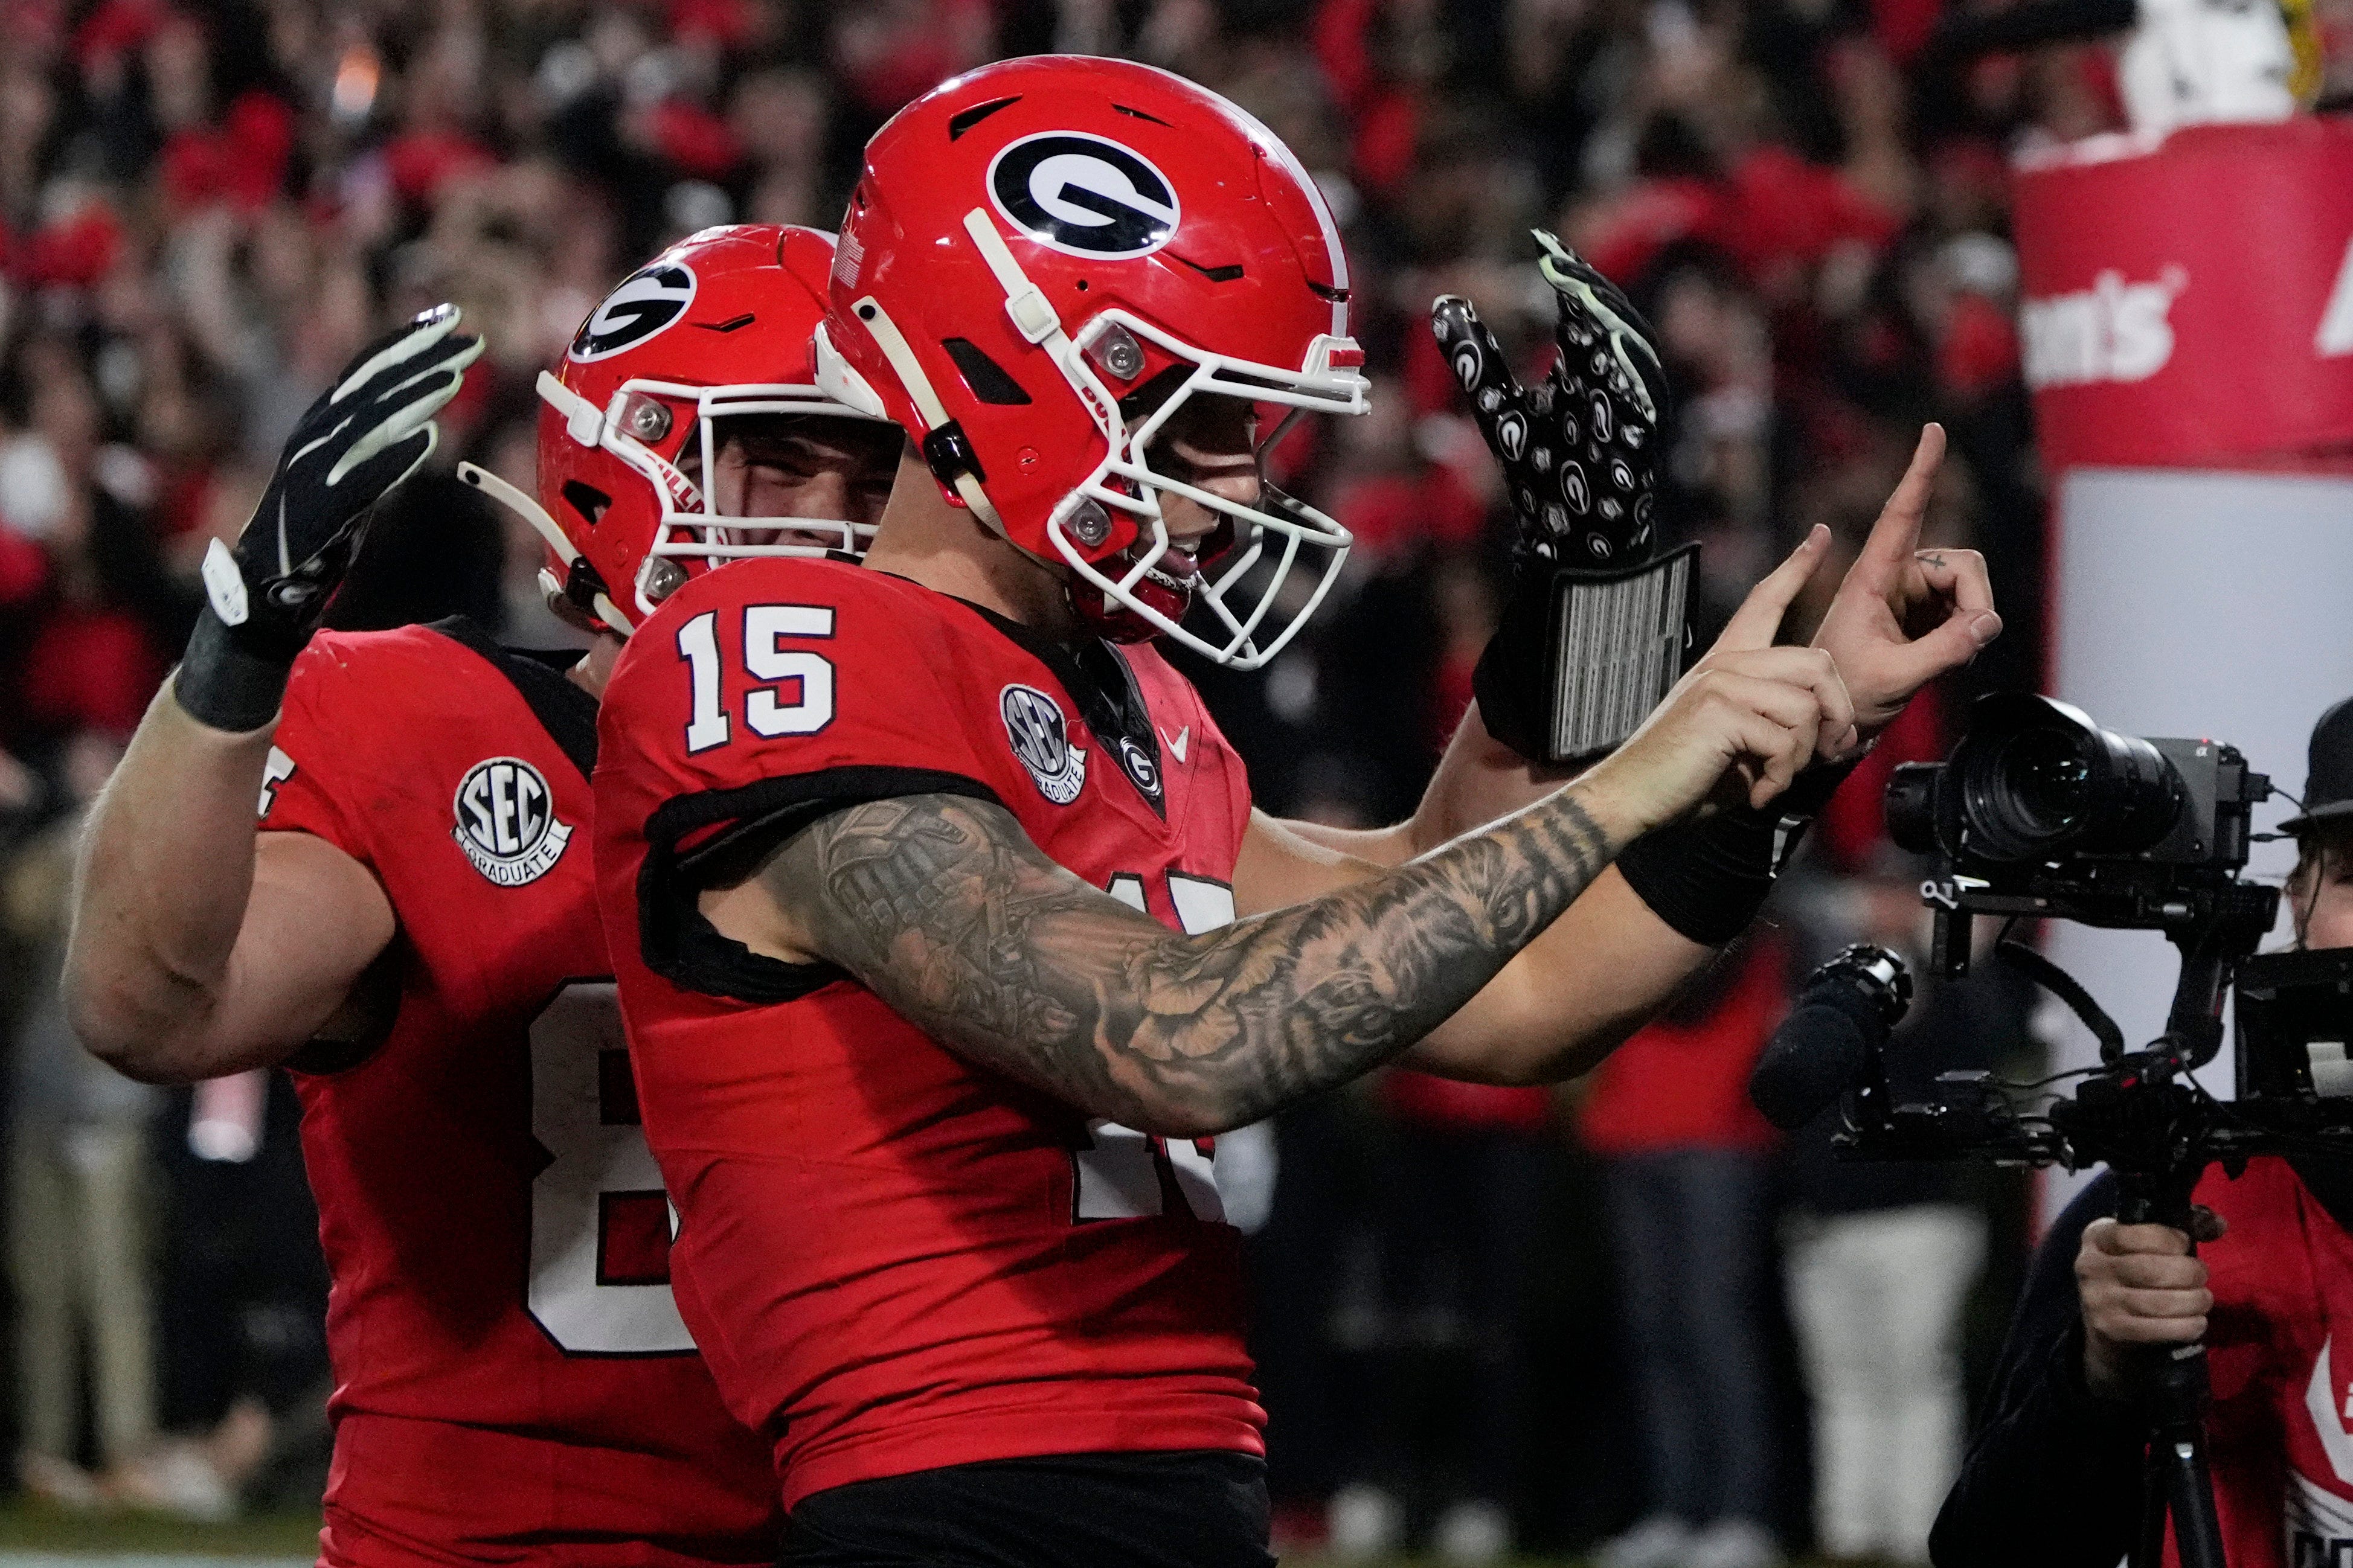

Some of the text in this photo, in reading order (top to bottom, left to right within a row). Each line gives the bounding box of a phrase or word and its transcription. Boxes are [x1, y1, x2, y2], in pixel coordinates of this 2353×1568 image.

[994, 136, 1173, 252] G
[572, 265, 691, 356] G
[675, 603, 836, 757] 15
[1007, 690, 1064, 773] SEC
[1125, 746, 1155, 787] G
[463, 765, 542, 853] SEC
[1033, 766, 1082, 801] RADUATE
[469, 844, 557, 883] GRADUATE
